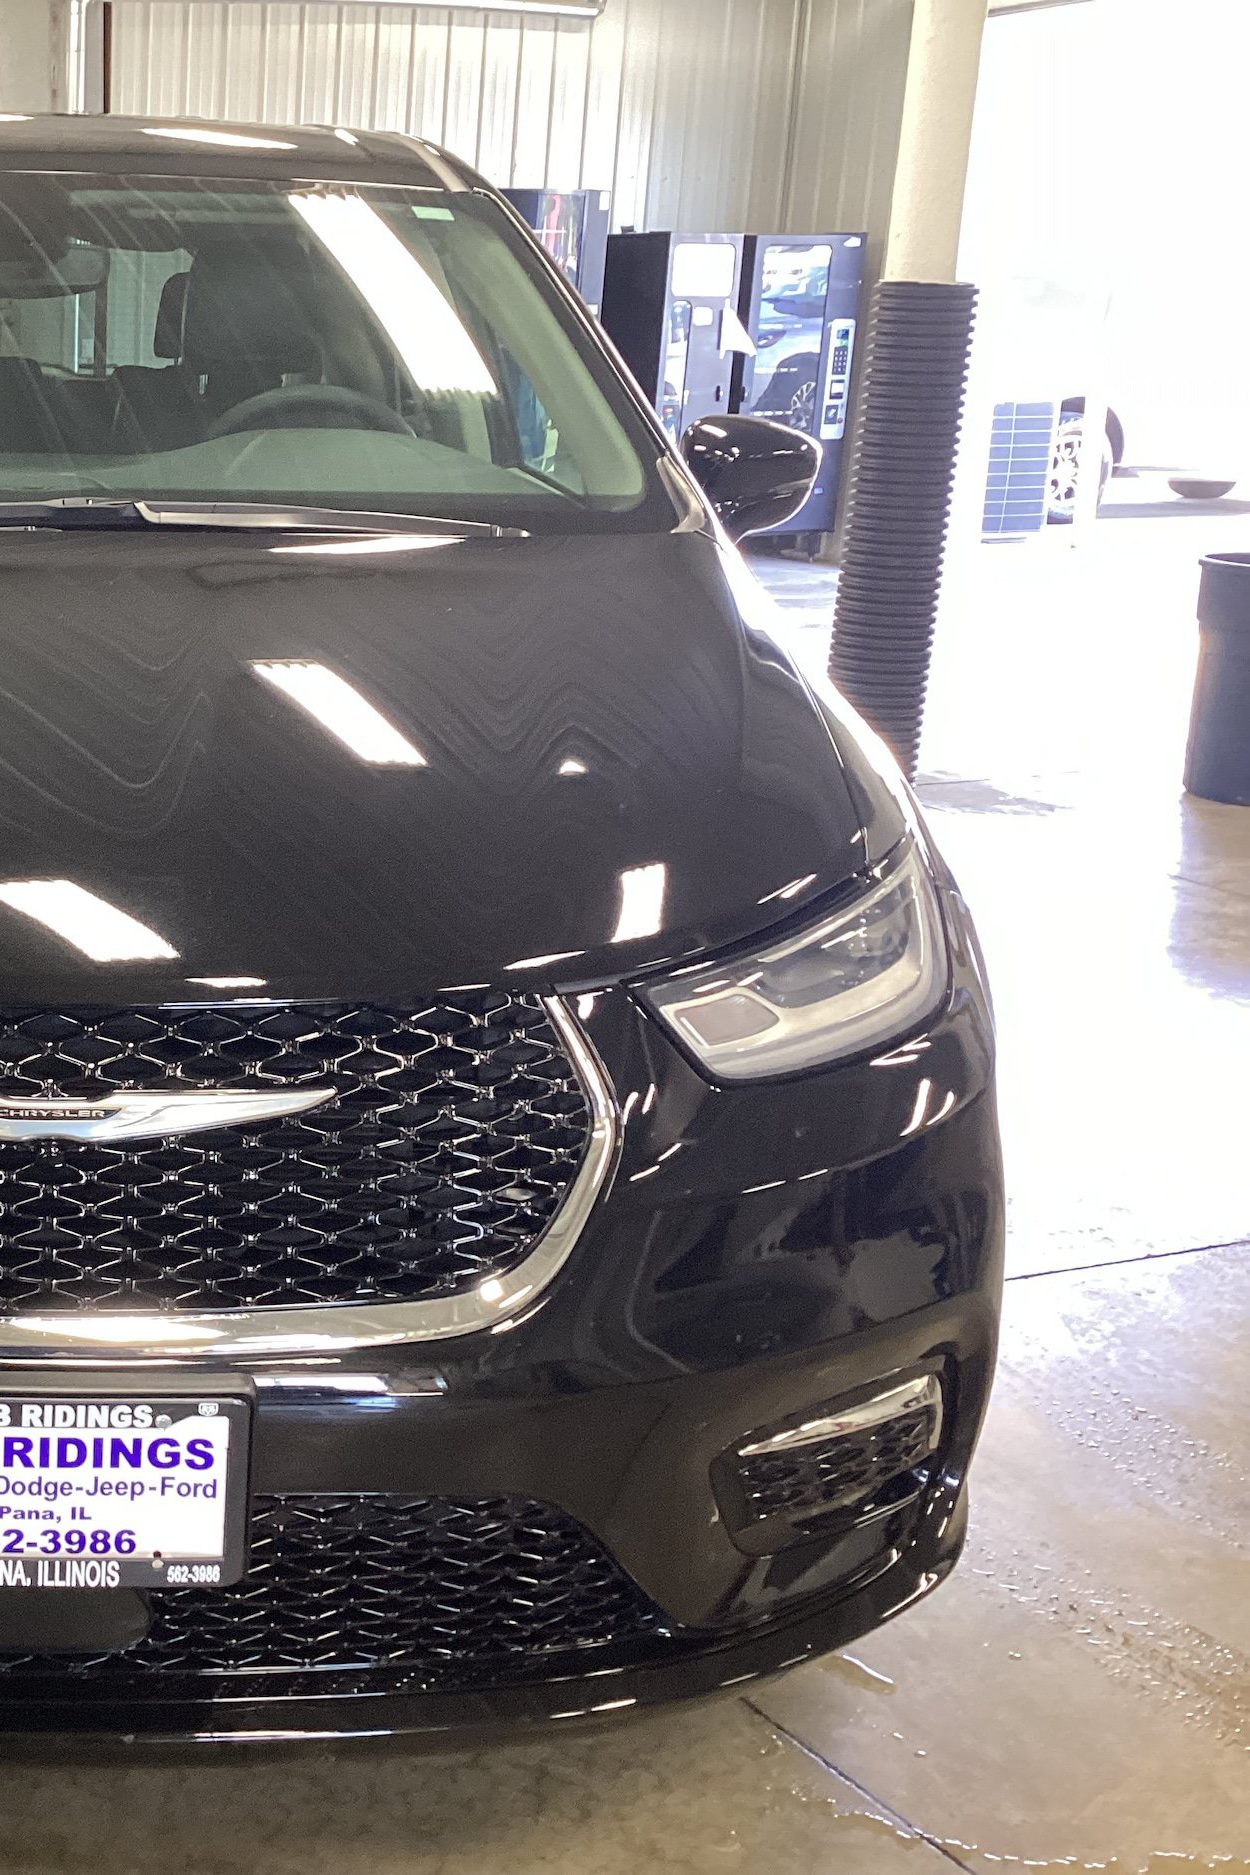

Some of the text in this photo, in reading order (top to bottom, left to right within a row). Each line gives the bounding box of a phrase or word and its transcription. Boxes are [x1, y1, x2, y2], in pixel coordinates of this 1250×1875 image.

[21, 1403, 154, 1429] RIDINGS
[3, 1436, 215, 1470] RIDINGS
[70, 1506, 92, 1521] IL
[37, 1560, 120, 1588] ILLINOIS
[166, 1564, 221, 1583] 562-3986
